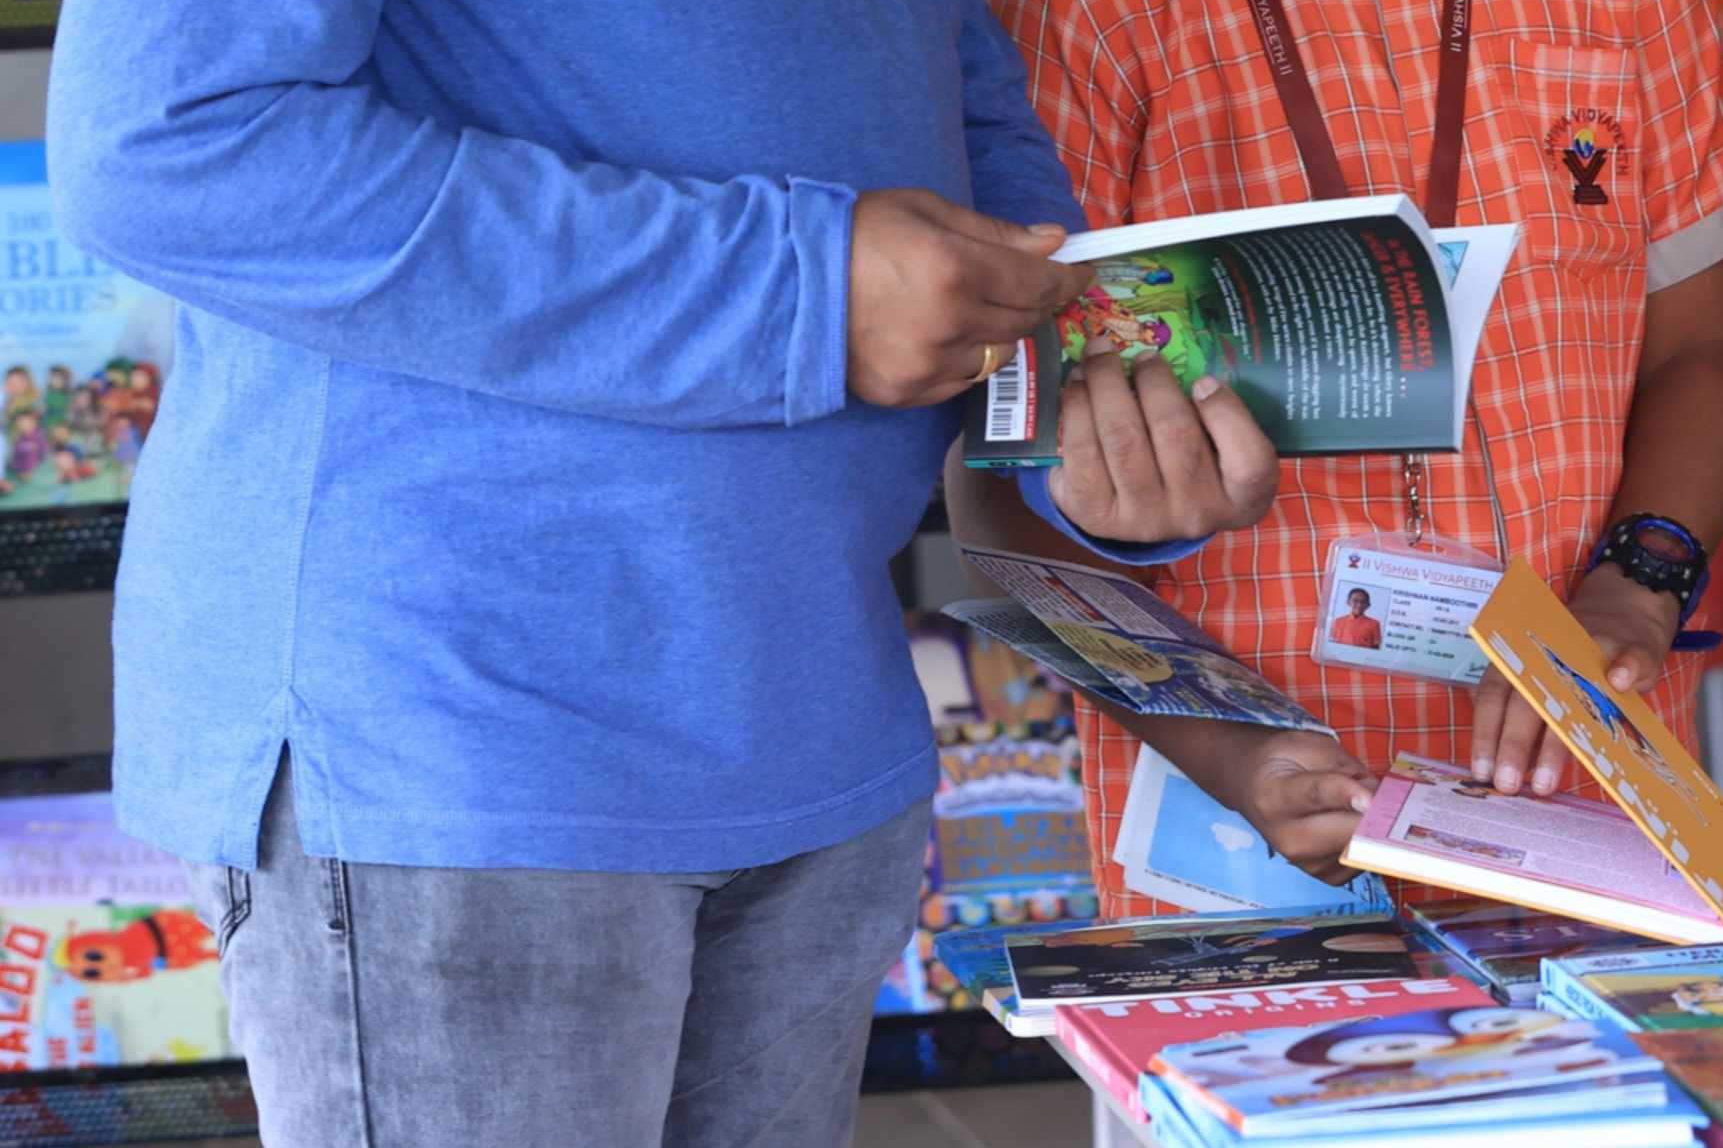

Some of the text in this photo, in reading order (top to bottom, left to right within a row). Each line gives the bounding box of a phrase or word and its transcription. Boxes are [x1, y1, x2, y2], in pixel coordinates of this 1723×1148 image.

[1373, 561, 1420, 578] VISHWA
[1422, 569, 1494, 590] VIDYAPEETH
[1083, 978, 1459, 1018] TINKLE
